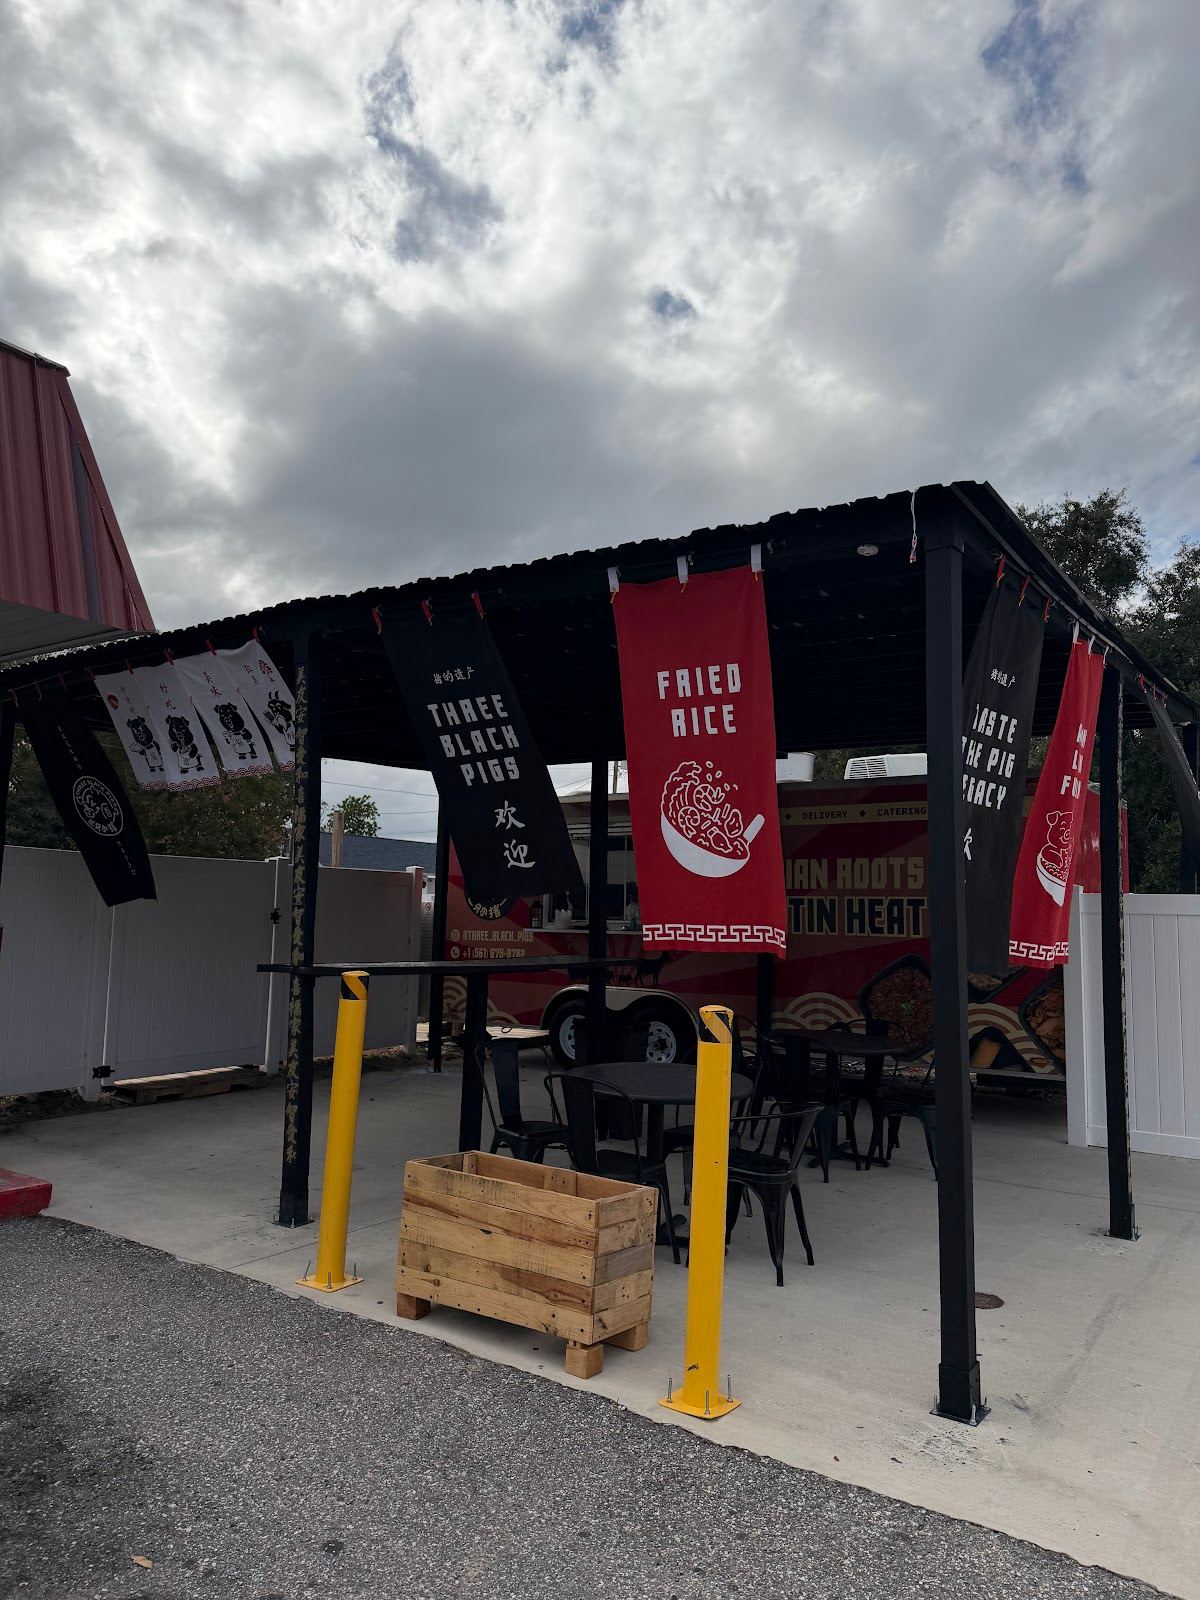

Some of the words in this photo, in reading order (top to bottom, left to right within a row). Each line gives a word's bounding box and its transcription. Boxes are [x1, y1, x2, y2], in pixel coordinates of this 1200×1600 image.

[656, 663, 742, 700] FRIED
[427, 693, 509, 728] THREE
[671, 704, 737, 737] RICE
[439, 724, 520, 758] BLACK
[460, 756, 520, 786] PIGS
[986, 747, 1016, 778] PIG
[802, 810, 848, 820] DELIVERY
[877, 807, 927, 817] CATERING
[494, 800, 536, 869] 欢迎
[836, 856, 926, 890] ROOTS
[844, 896, 928, 937] HEAT
[462, 948, 471, 959] +1
